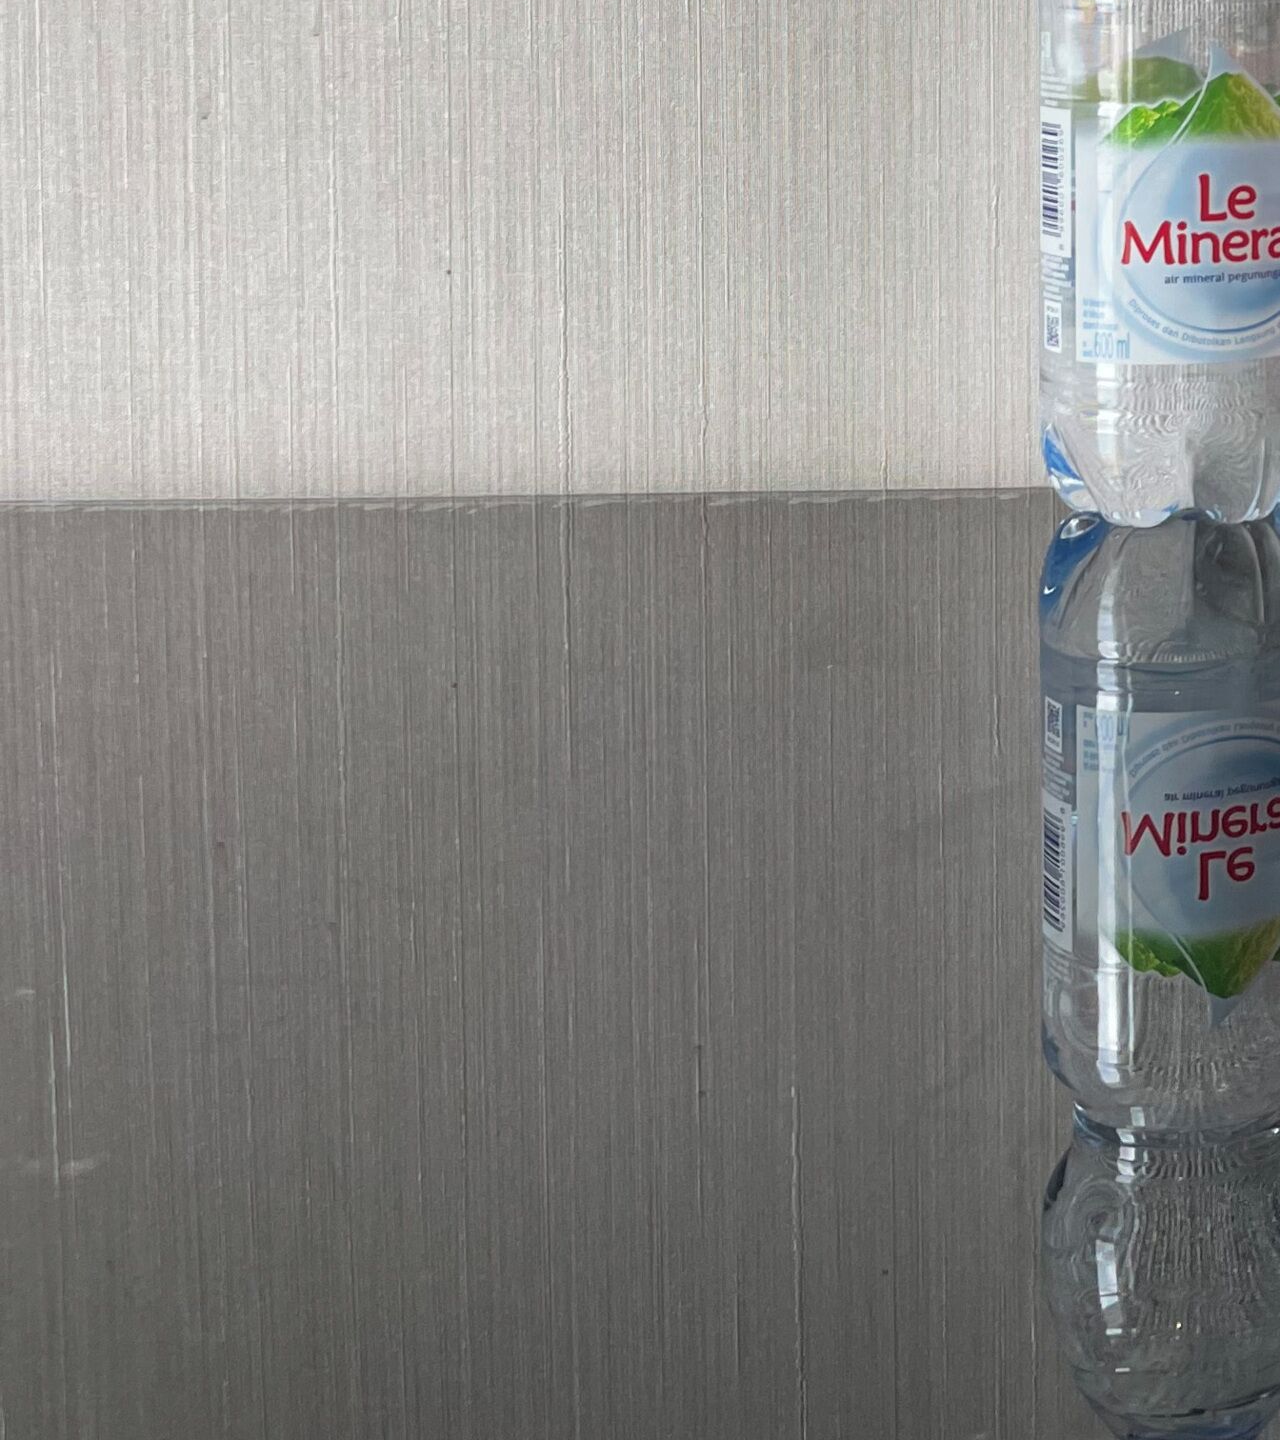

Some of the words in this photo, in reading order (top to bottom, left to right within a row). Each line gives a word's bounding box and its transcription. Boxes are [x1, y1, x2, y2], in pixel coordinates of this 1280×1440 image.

[1198, 173, 1257, 222] Le
[1164, 274, 1180, 285] air
[1182, 271, 1226, 284] mineral
[1115, 331, 1131, 359] ml
